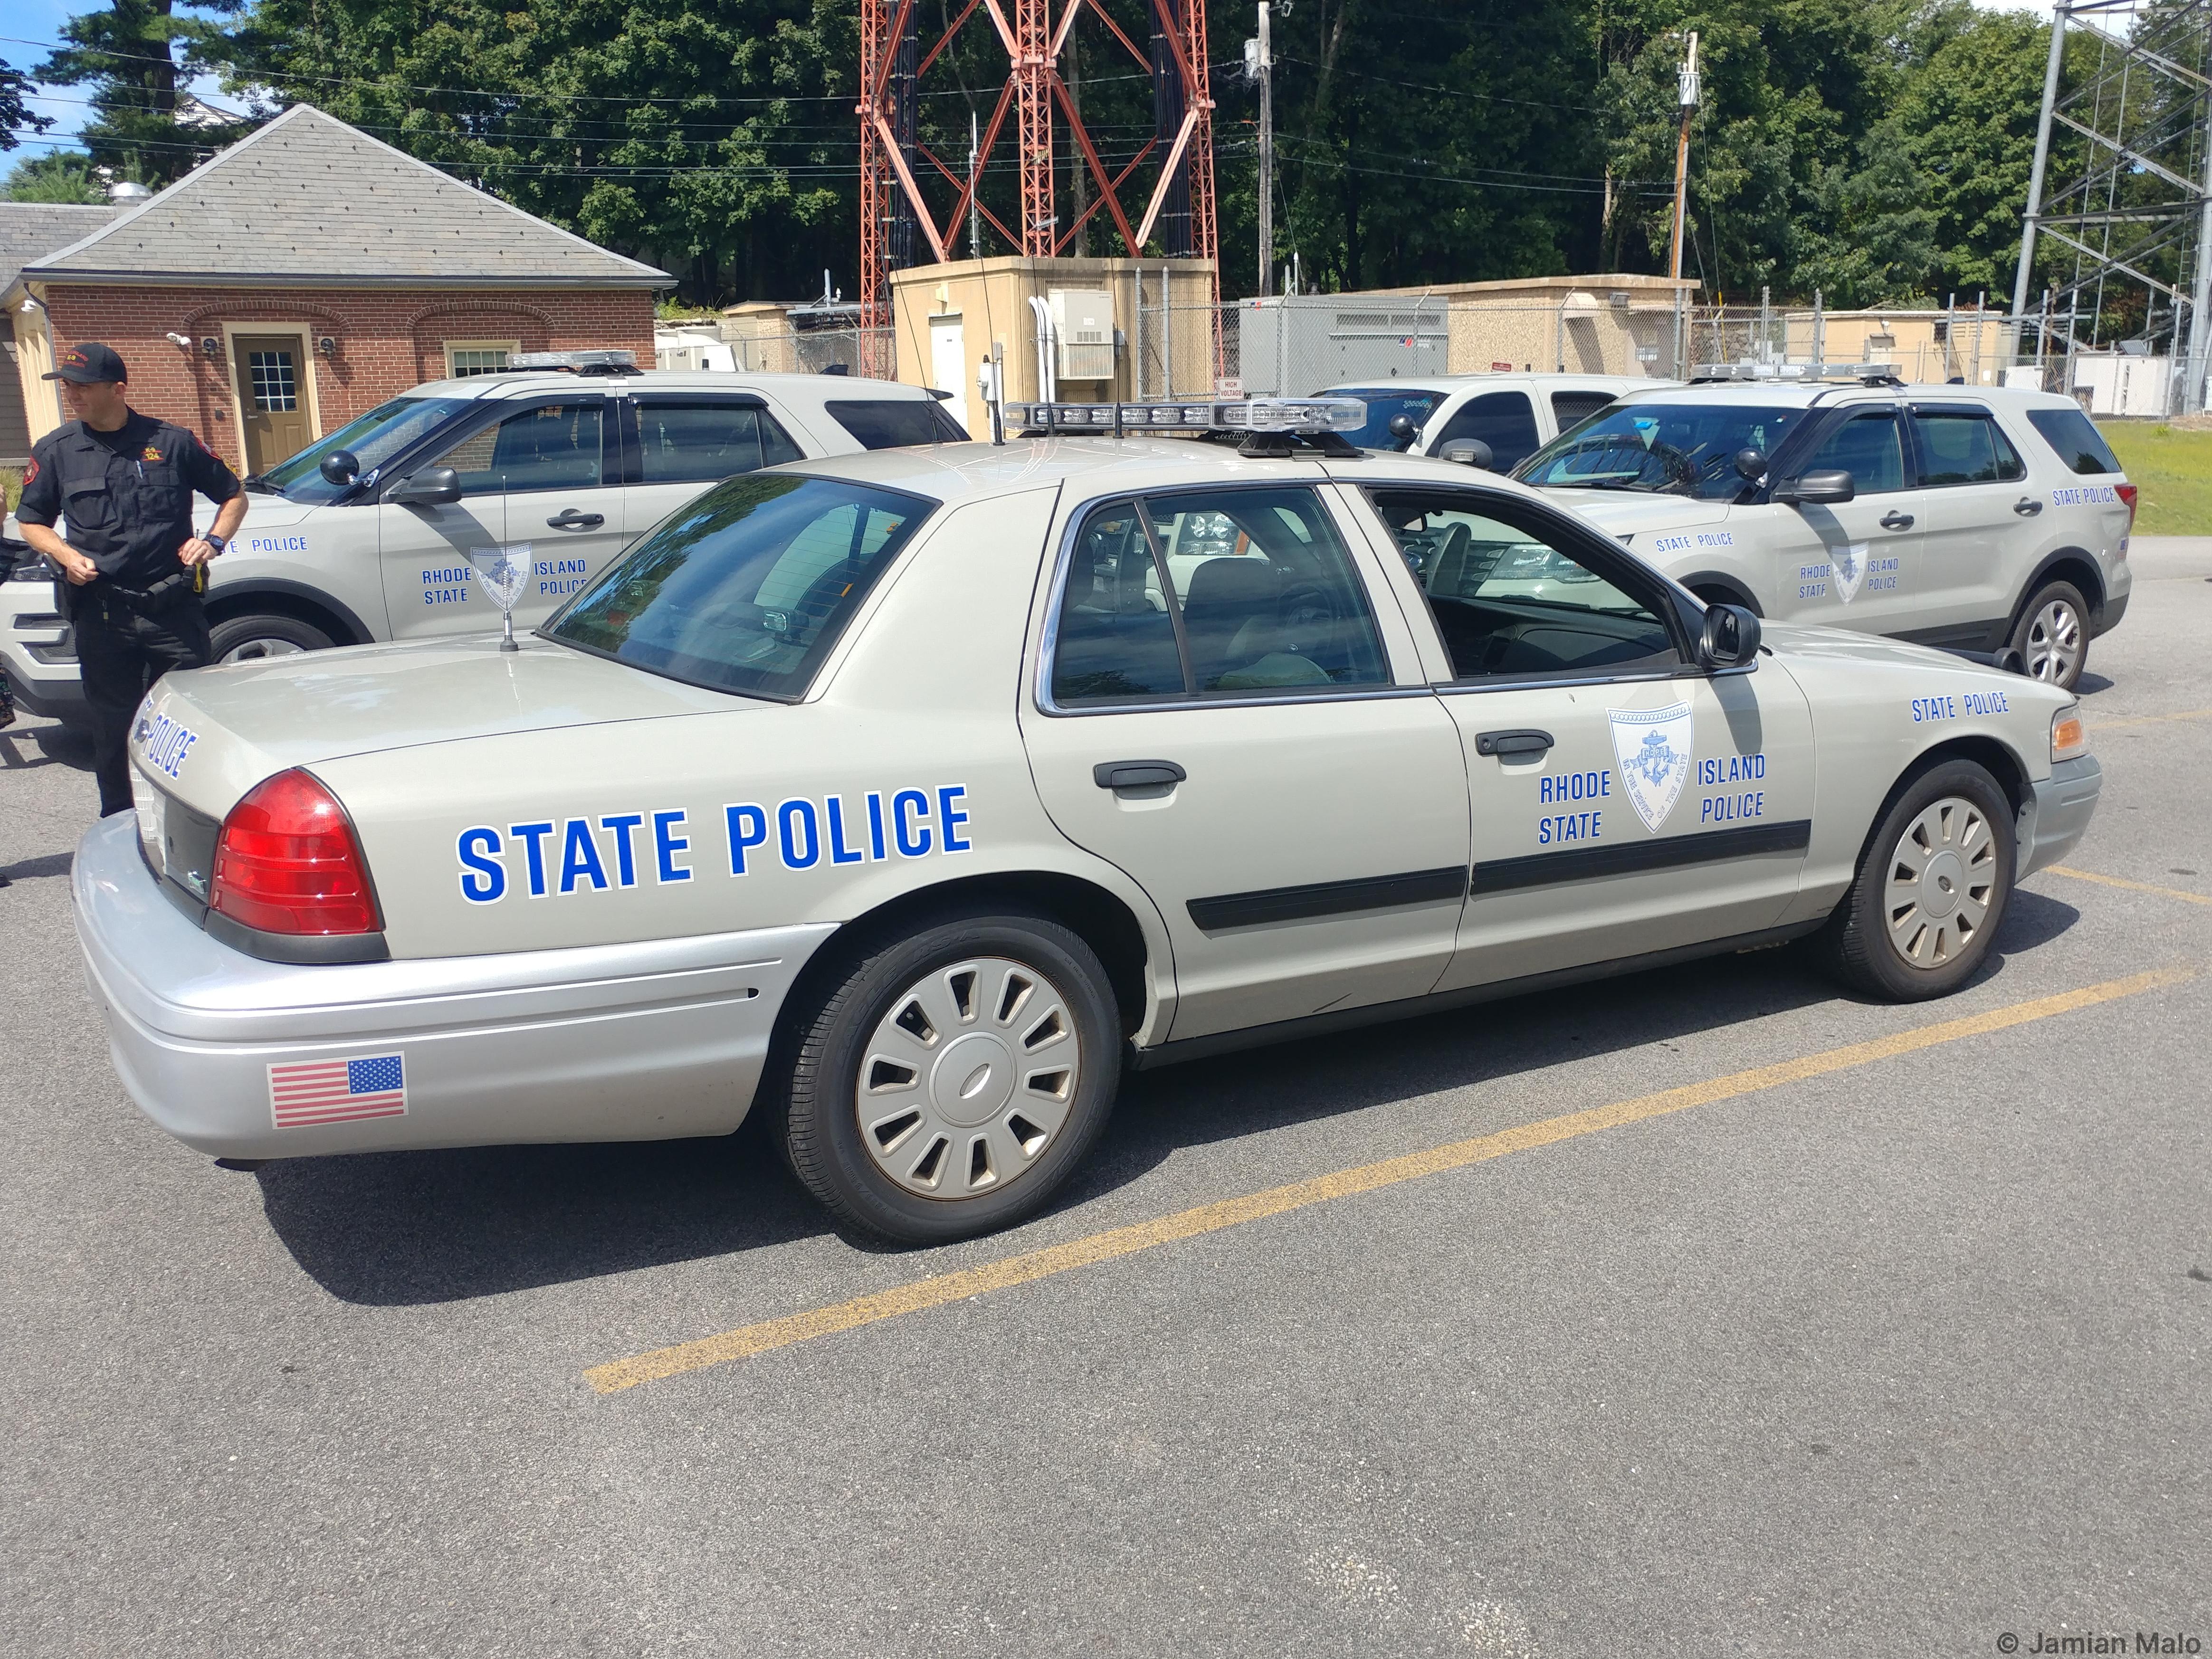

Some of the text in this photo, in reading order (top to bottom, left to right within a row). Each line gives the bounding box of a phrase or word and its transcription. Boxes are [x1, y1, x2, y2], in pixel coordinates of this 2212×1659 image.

[2052, 486, 2115, 507] STATE POLICE
[251, 536, 308, 553] POLICE
[1656, 532, 1734, 553] STATE POLICE
[422, 559, 586, 584] RHODE ISLAND
[1800, 558, 1899, 580] RHODE ISLAND
[424, 588, 468, 604] STATE
[1799, 584, 1826, 599] STATE
[1868, 576, 1897, 591] POLICE
[1911, 691, 2010, 724] STATE POLICE
[142, 712, 200, 780] POLICE
[1645, 748, 1665, 757] HOPE
[1539, 753, 1765, 805] RHODE ISLAND
[1622, 753, 1688, 821] IN THE SERVICE OF THE STATE
[1538, 790, 1764, 845] STATE POLICE
[456, 782, 974, 906] STATE POLICE
